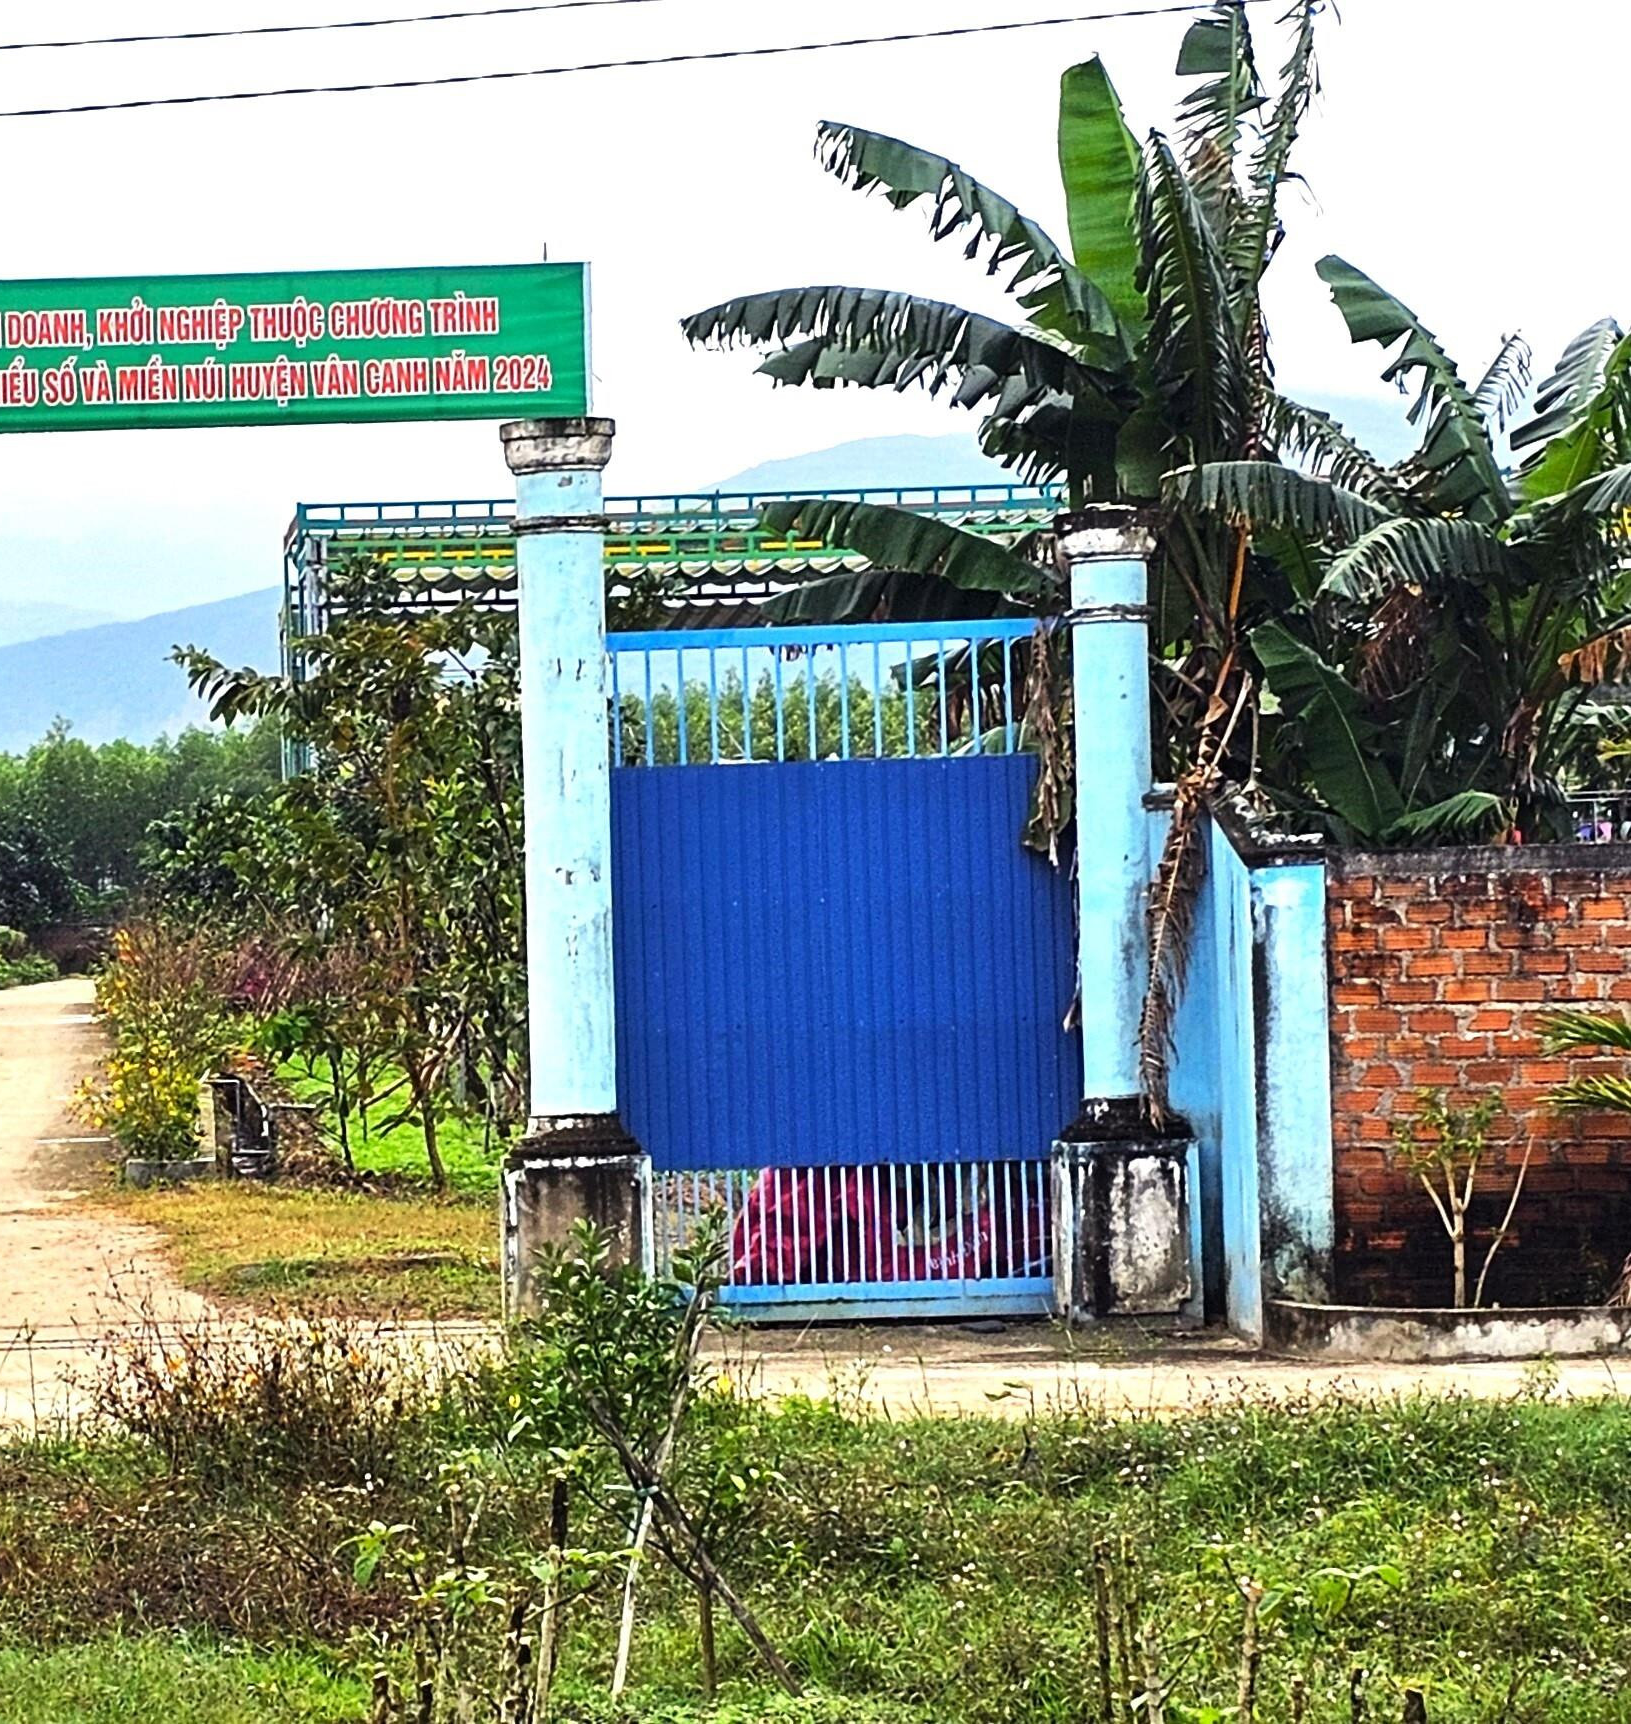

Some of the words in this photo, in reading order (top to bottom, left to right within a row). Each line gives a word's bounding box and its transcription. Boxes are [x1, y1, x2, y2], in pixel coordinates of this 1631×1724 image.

[4, 309, 94, 351] DOANH,
[96, 295, 154, 346] KHỞI
[157, 297, 246, 350] NGHIỆP
[248, 295, 325, 348] THUỘC
[327, 296, 425, 339] CHƯƠNG
[427, 290, 500, 335] TRÌNH
[42, 355, 78, 407] SỐ
[79, 359, 114, 405] VÀ
[115, 354, 179, 404] MIỀN
[182, 356, 226, 402] NÚI
[229, 354, 308, 408] HUYỆN
[309, 352, 361, 400] VÂN
[363, 357, 430, 397] CANH
[432, 350, 490, 395] NĂM
[493, 354, 553, 393] 2024
